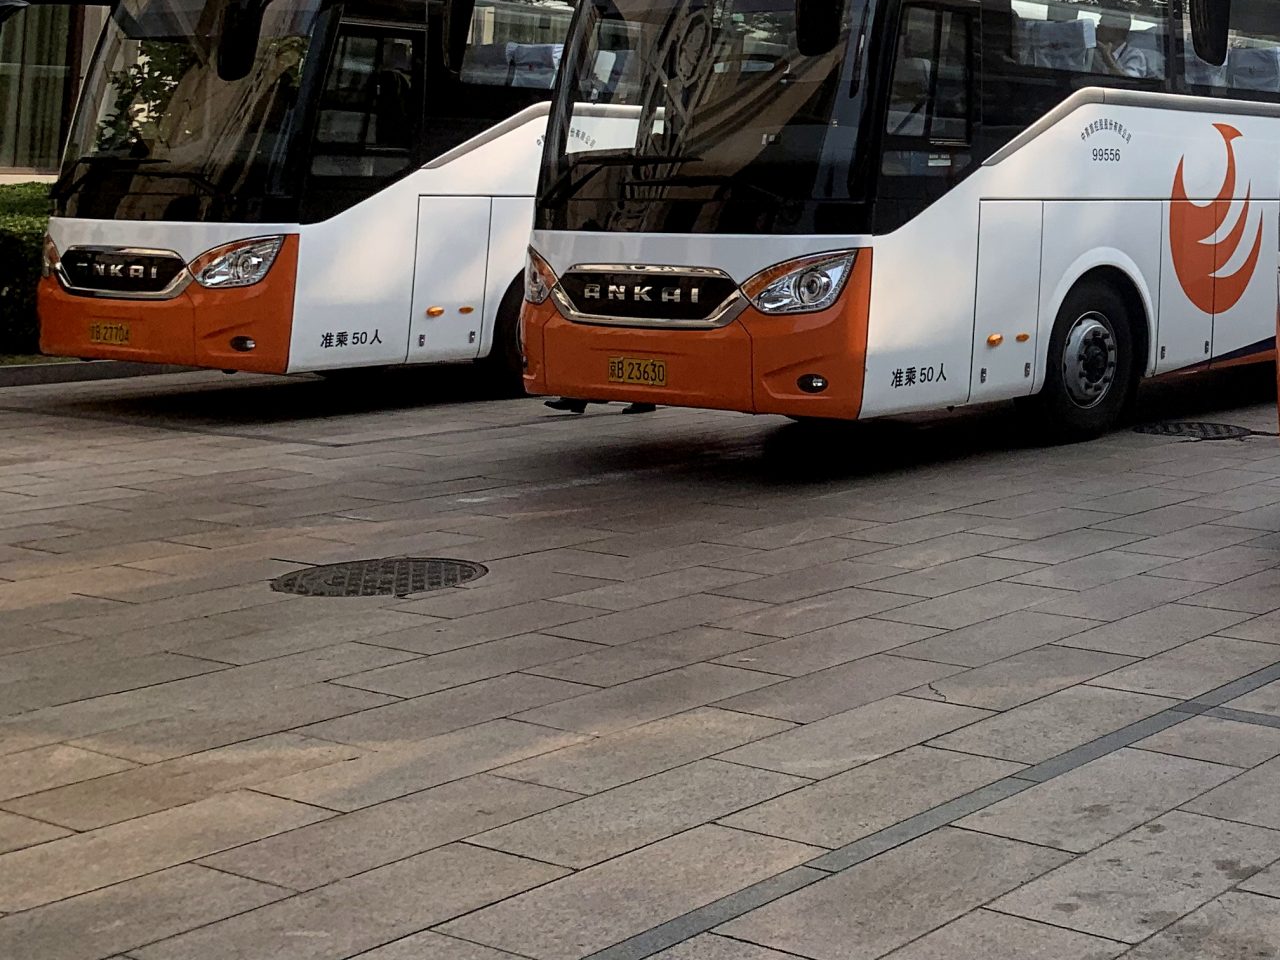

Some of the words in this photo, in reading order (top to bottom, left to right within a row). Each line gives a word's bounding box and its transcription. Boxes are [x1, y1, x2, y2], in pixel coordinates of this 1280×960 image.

[1092, 147, 1121, 162] 99556
[584, 284, 700, 304] ANKAI
[320, 329, 382, 348] 准乘50人
[890, 362, 947, 389] 准乘50人
